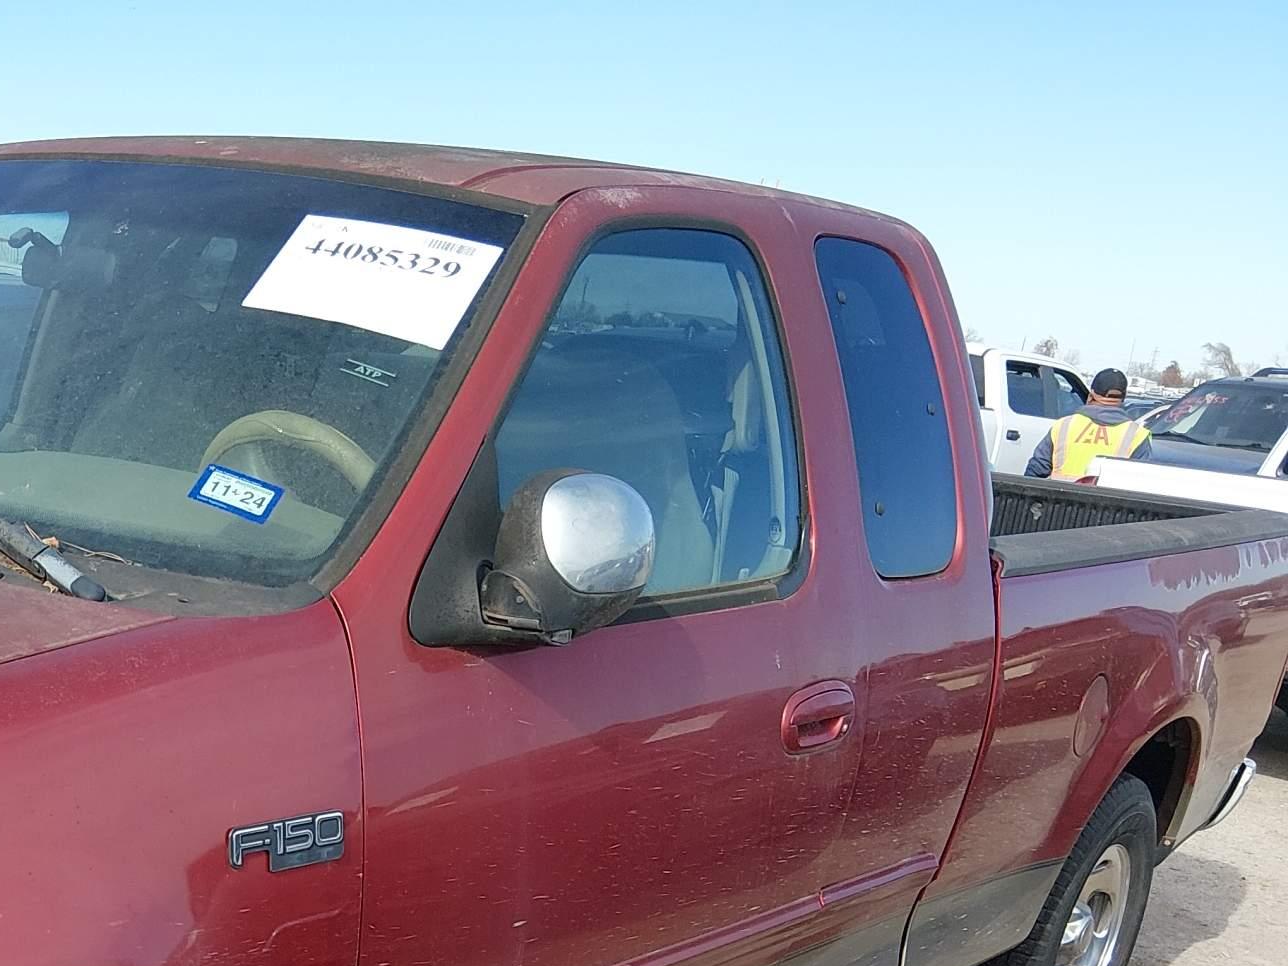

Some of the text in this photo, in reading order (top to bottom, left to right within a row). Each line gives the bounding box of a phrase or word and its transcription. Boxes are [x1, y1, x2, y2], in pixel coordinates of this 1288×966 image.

[305, 238, 462, 278] 44085329
[354, 366, 382, 378] ATP
[232, 812, 343, 866] F-150
